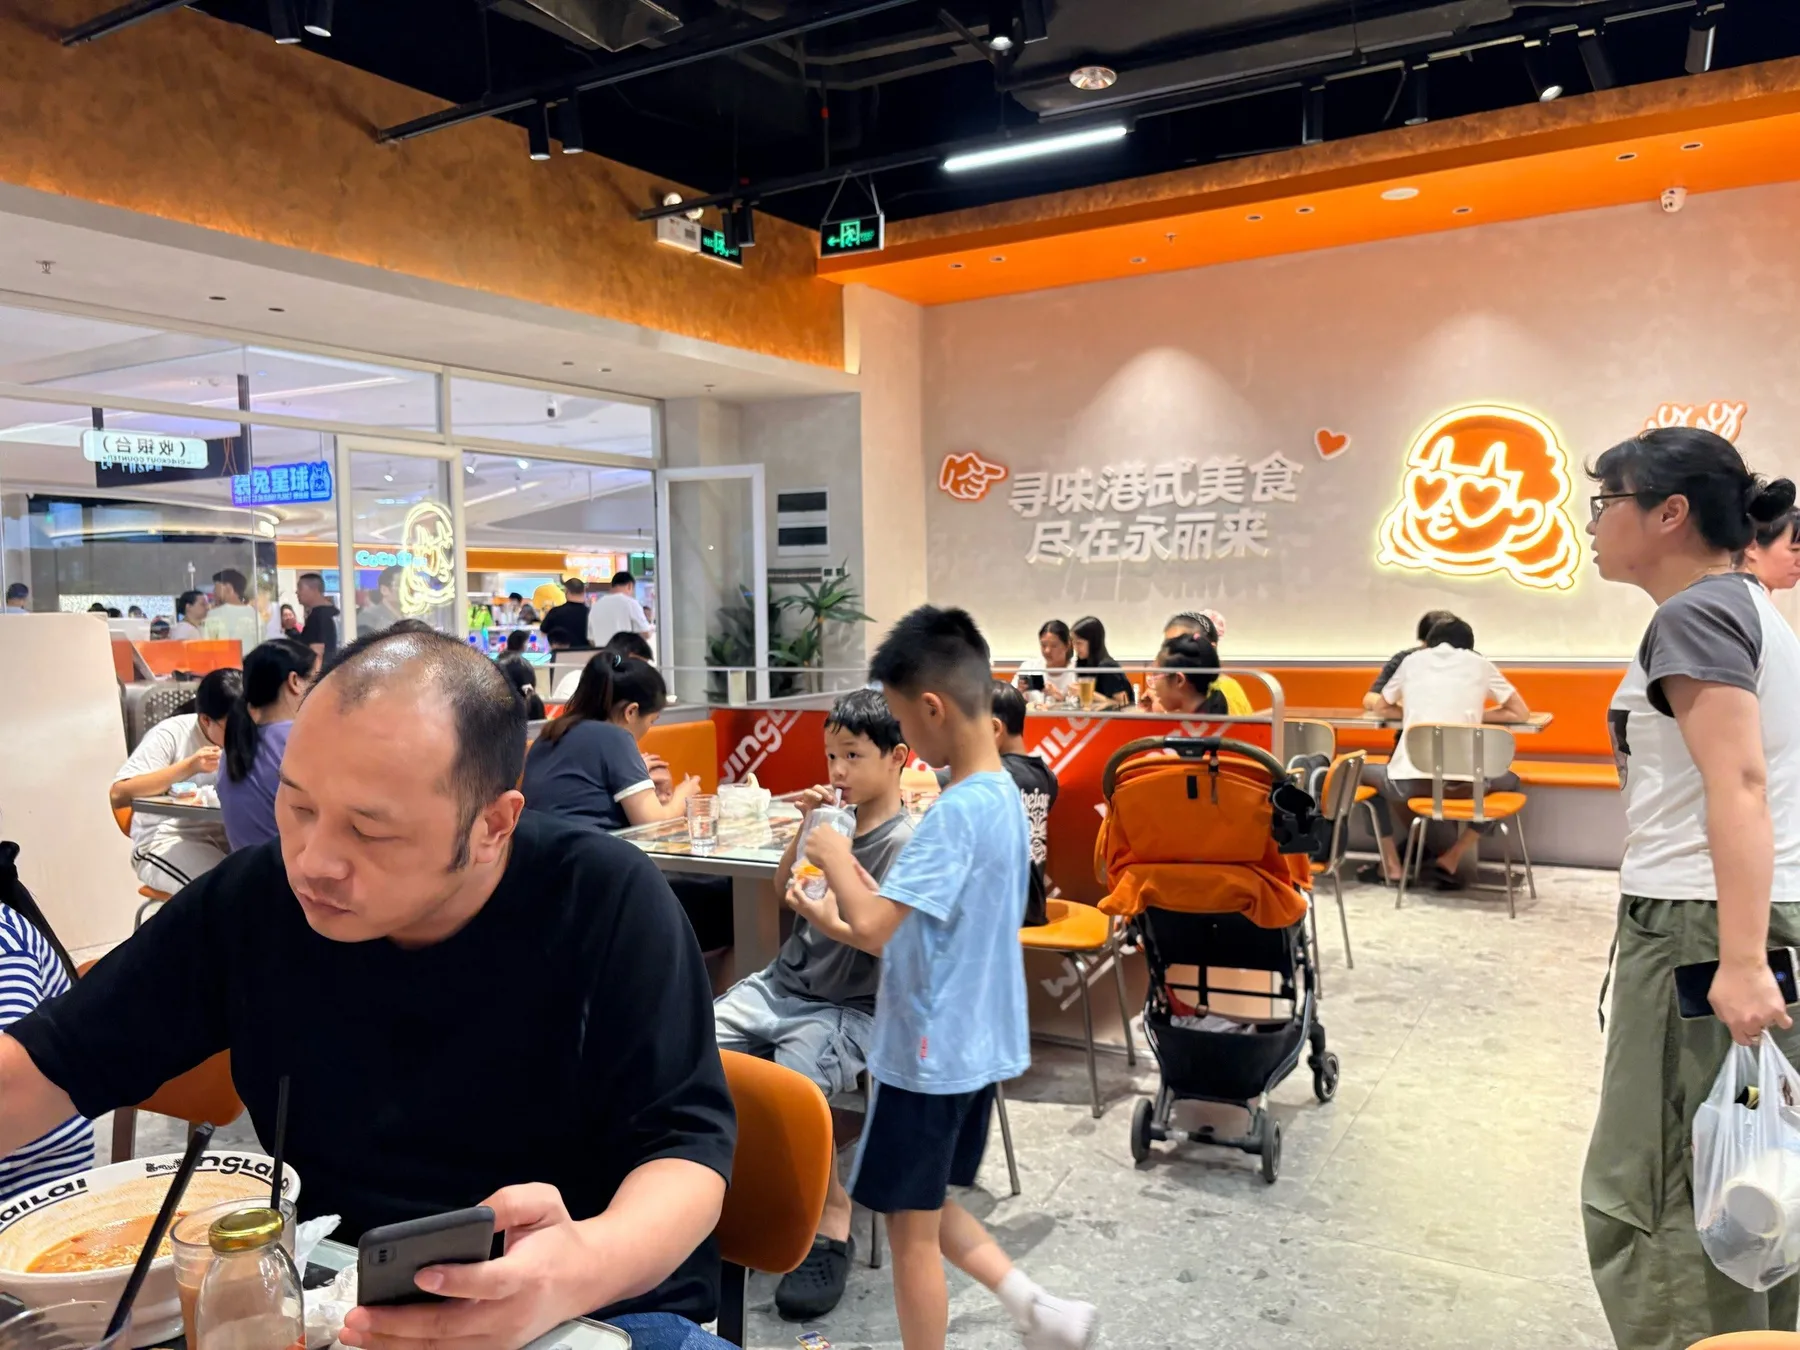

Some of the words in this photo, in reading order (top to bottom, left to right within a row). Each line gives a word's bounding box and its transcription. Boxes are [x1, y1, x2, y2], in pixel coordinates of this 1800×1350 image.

[1008, 450, 1303, 518] 寻味港式美食
[1025, 508, 1270, 566] 尽在永丽来
